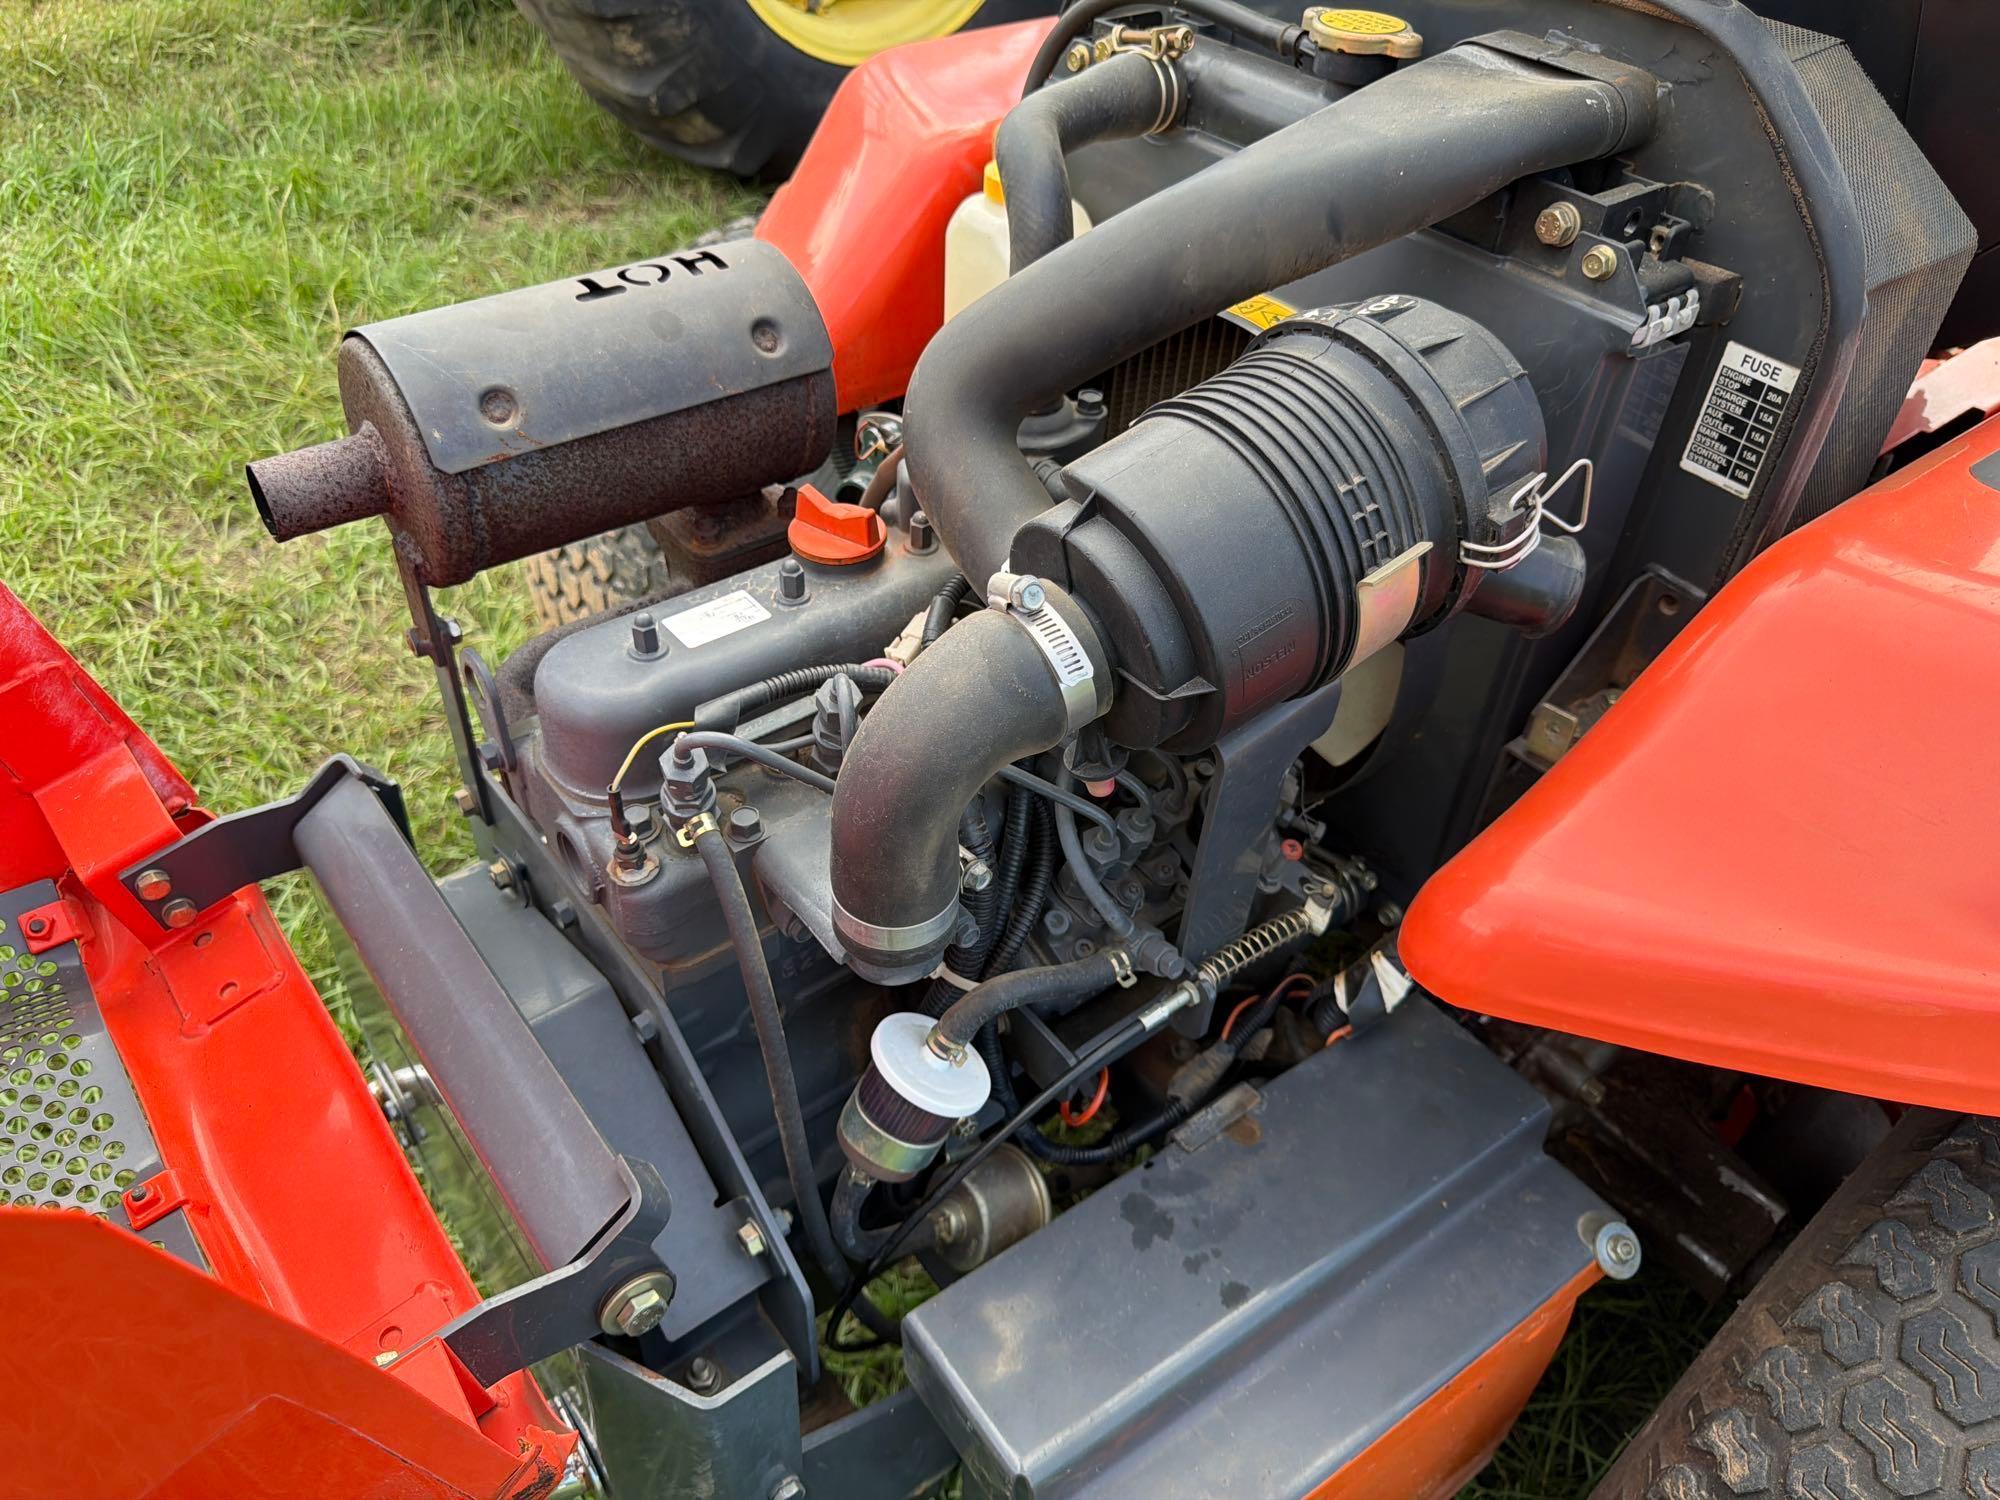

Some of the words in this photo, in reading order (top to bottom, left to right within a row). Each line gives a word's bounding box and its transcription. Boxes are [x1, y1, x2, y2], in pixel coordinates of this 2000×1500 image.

[575, 251, 729, 302] HOT
[1721, 368, 1752, 386] ENGINE
[1741, 354, 1782, 382] FUSE
[1718, 376, 1740, 390] STOP
[1710, 396, 1743, 415] SYSTEM
[1714, 388, 1747, 406] CHARGE
[1766, 392, 1781, 404] 20A
[1702, 416, 1734, 433] OUTLET
[1759, 412, 1773, 424] 15A
[1698, 426, 1718, 440] MAIN
[1751, 431, 1765, 444] 15A
[1695, 435, 1728, 453] SYSTEM
[1687, 453, 1719, 472] SYSTEM
[1691, 444, 1728, 467] CONTROL
[1245, 640, 1296, 680] NELSON
